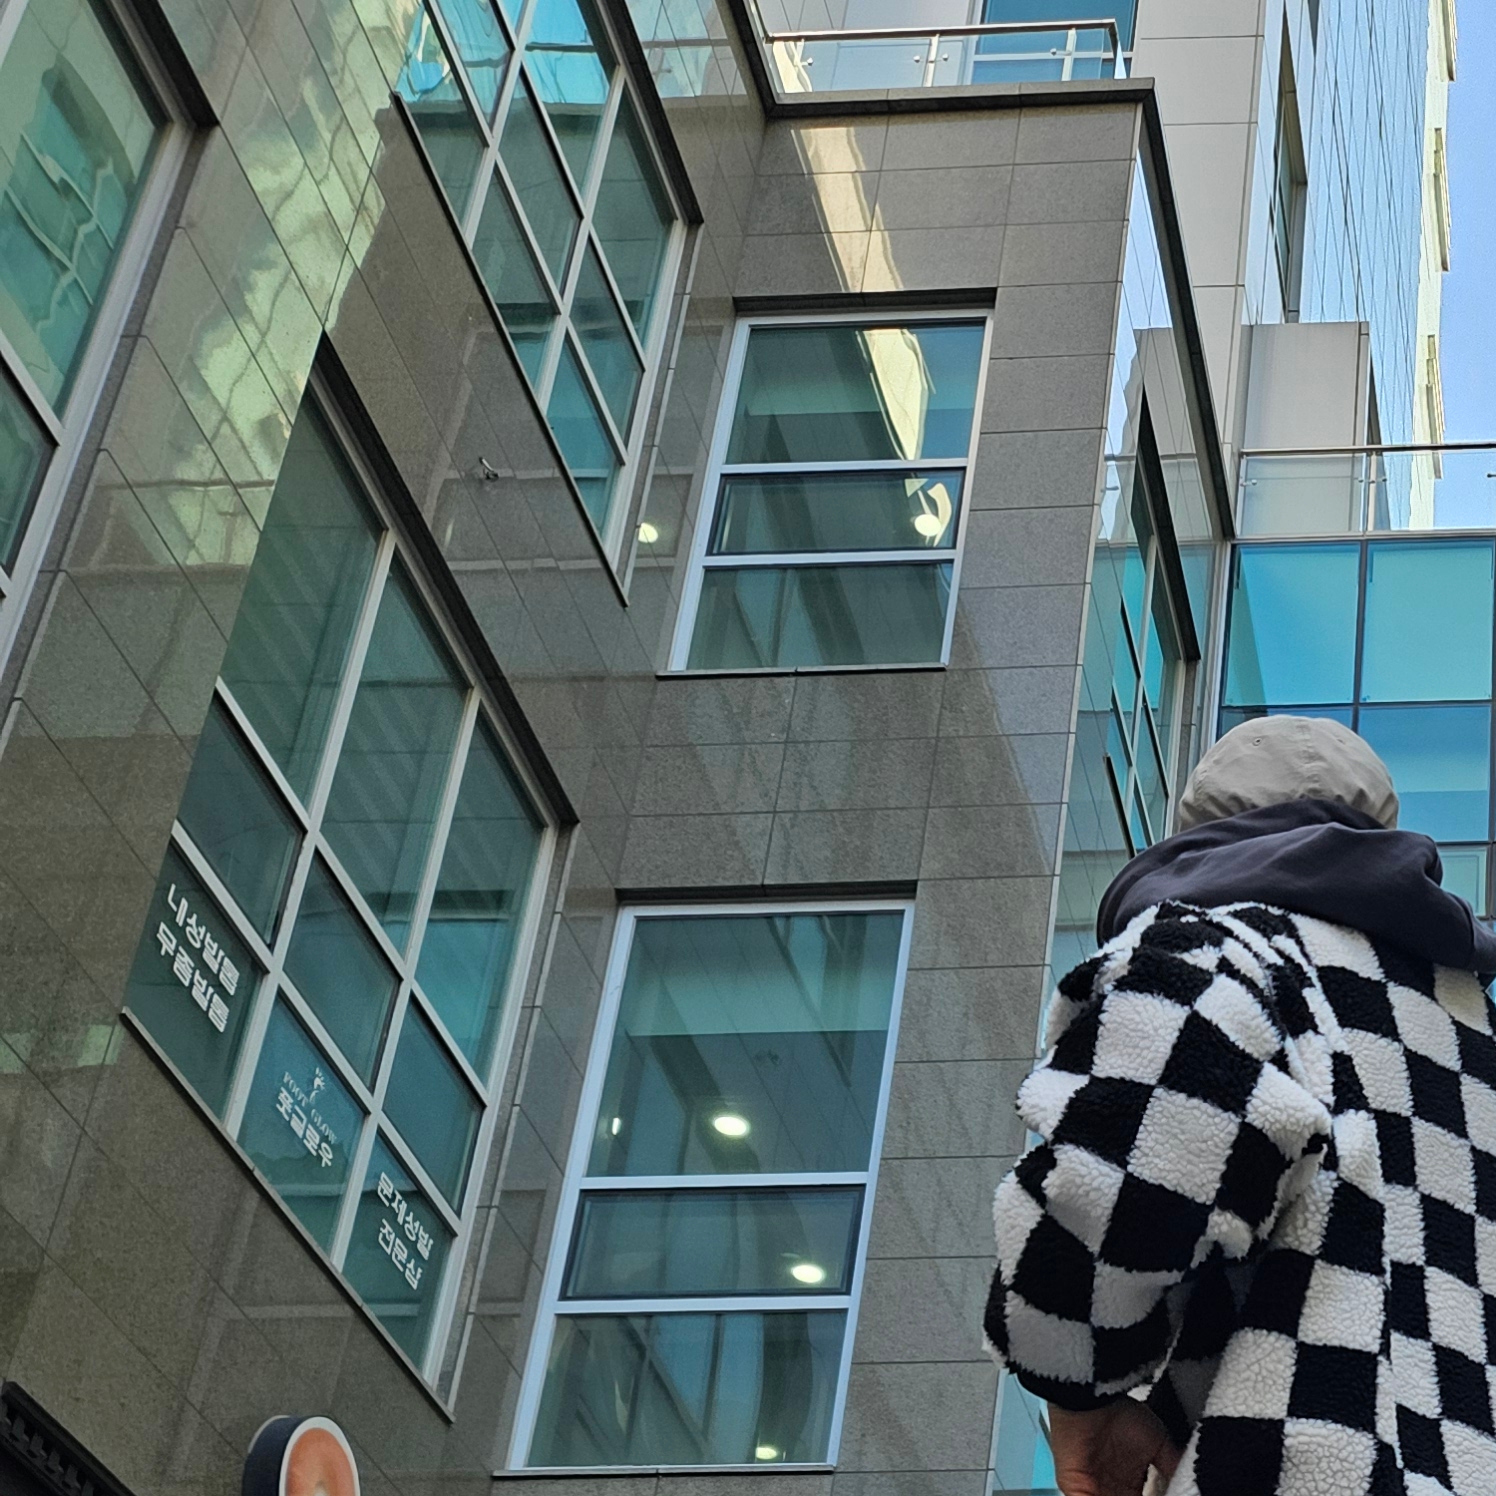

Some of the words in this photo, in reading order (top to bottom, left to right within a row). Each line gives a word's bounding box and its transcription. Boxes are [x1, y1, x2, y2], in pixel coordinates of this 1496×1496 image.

[156, 921, 230, 1033] 무좀발톱
[167, 883, 240, 996] 내성발톱
[275, 1086, 333, 1168] 풋글로우
[283, 1071, 308, 1107] FOOT
[310, 1108, 337, 1145] GLOW
[377, 1171, 434, 1261] 문제성발
[378, 1218, 423, 1291] 전문샵
